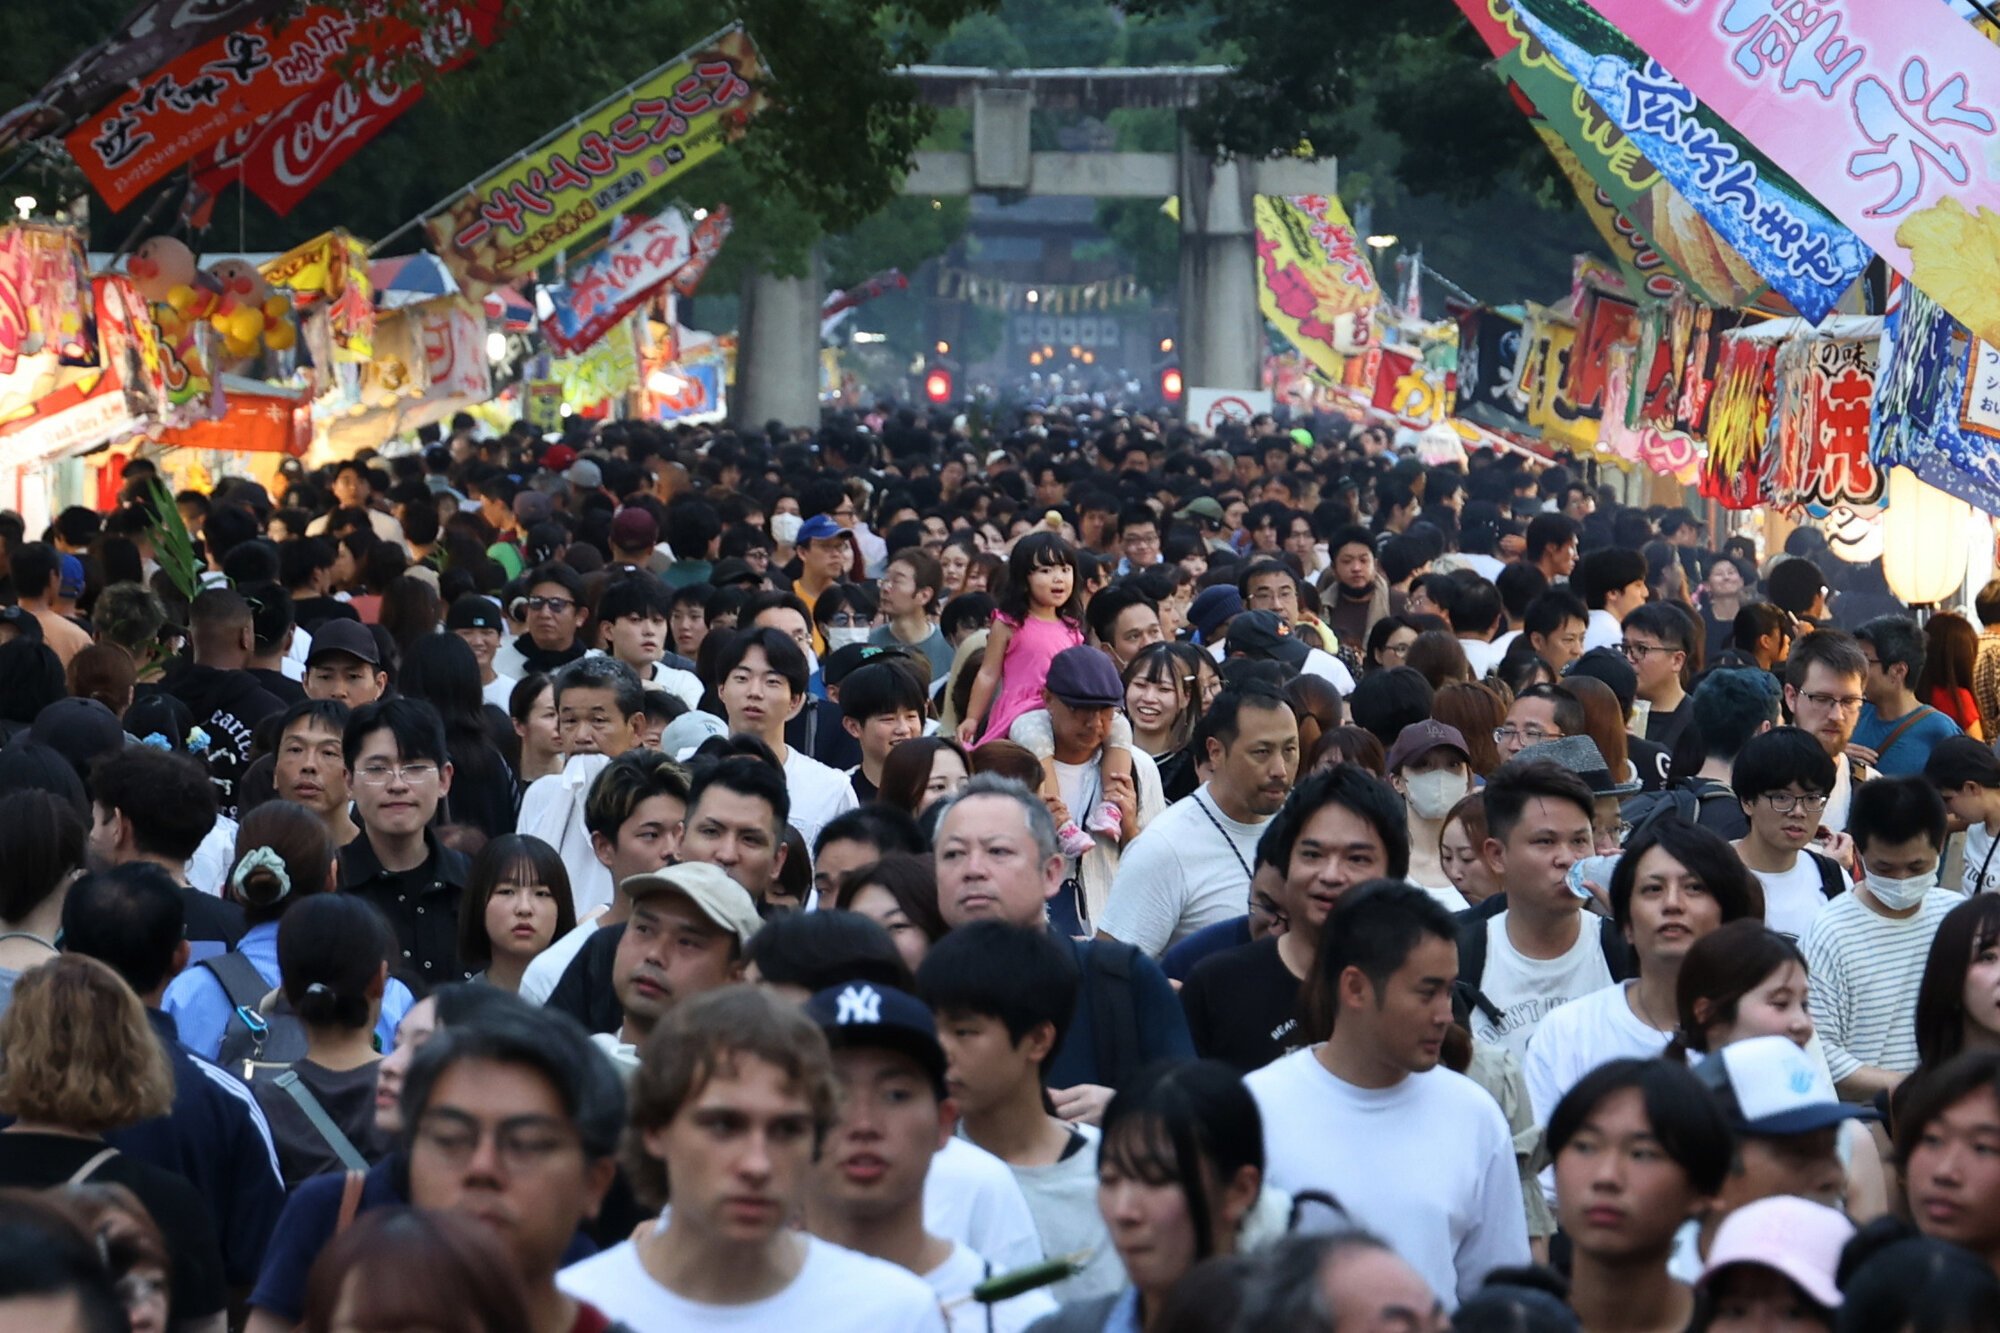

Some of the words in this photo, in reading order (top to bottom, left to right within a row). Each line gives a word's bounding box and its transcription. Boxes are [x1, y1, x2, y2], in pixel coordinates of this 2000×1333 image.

[272, 8, 473, 187] CocaCla
[456, 61, 748, 247] パリパリウインナー
[836, 985, 882, 1025] NY
